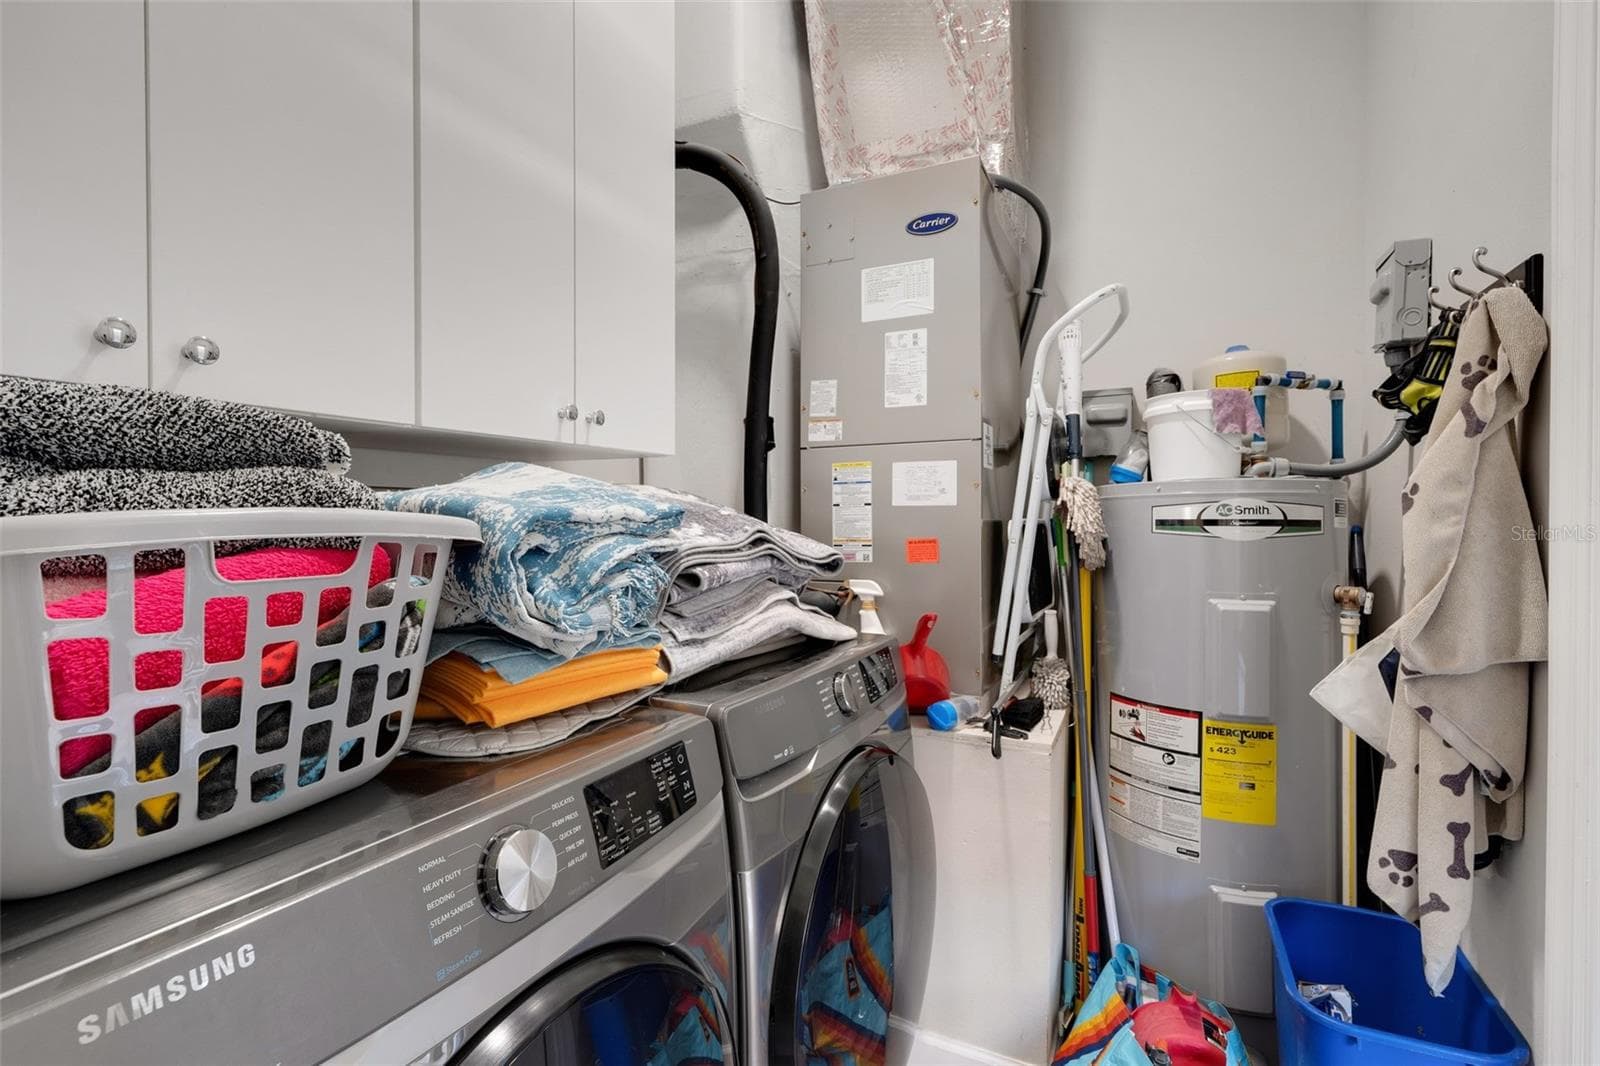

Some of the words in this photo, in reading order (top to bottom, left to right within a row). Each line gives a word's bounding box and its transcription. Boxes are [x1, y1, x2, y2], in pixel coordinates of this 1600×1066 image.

[913, 216, 951, 230] Carrier
[1234, 504, 1270, 515] Smith
[1216, 747, 1237, 755] 423
[551, 795, 575, 811] DELICATES
[558, 829, 573, 841] QUICK
[572, 825, 582, 834] DRY
[565, 843, 576, 853] TIME
[418, 856, 447, 873] NORMAL
[422, 876, 445, 894] HEAVY
[444, 868, 462, 883] DUTY
[426, 890, 456, 911] BEDDING
[429, 912, 451, 929] STEAM
[433, 924, 462, 946] REFRESH
[77, 943, 256, 1045] SAMSUNG
